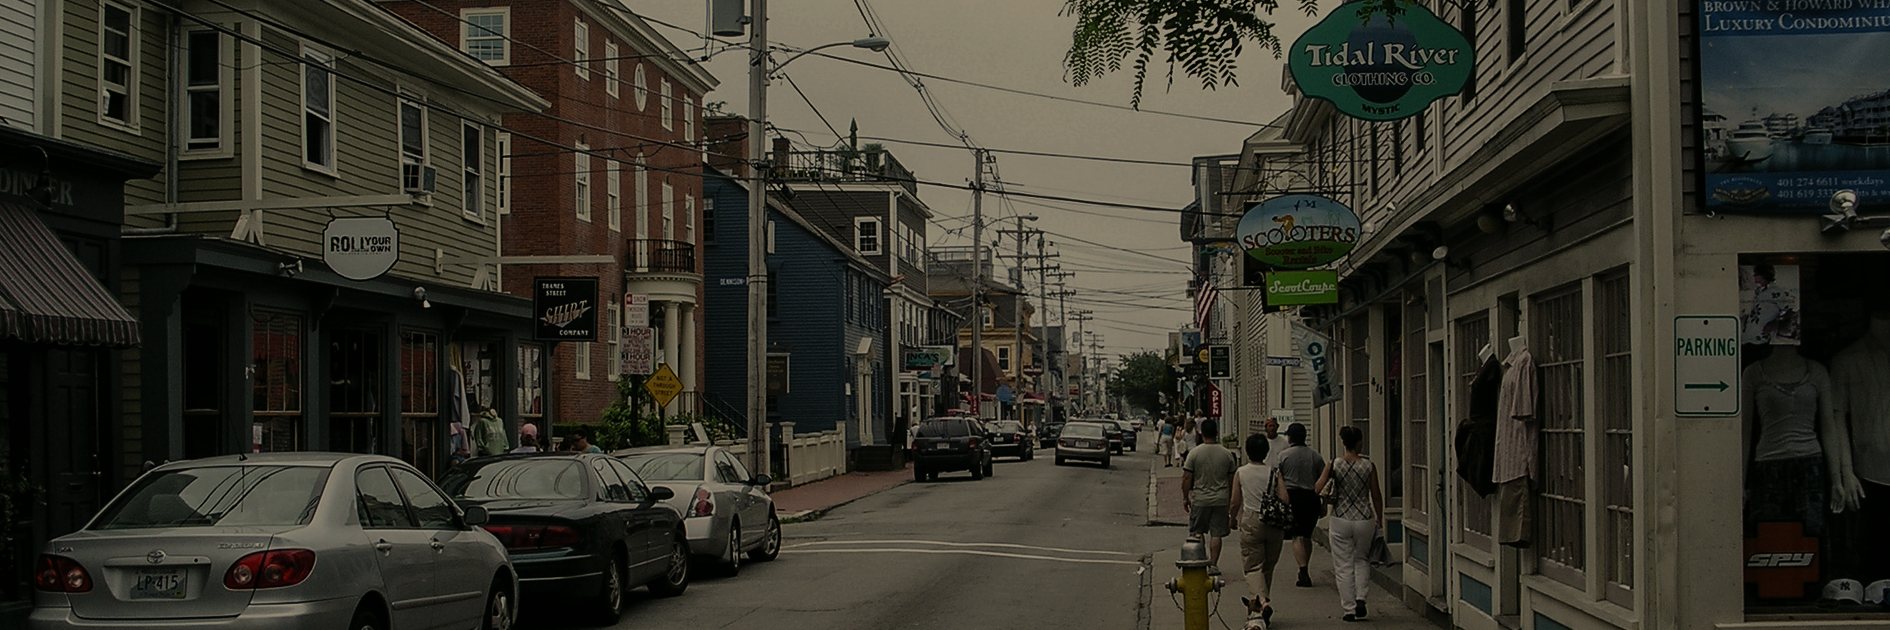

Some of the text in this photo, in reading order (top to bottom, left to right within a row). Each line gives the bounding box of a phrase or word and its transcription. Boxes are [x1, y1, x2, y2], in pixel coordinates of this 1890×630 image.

[1704, 0, 1761, 13] BROWN
[1766, 0, 1780, 11] &
[1785, 0, 1852, 11] HOWARD
[1704, 14, 1775, 32] LUXURY
[1304, 41, 1459, 70] Tidal River
[1332, 72, 1437, 87] CLOTHING CO.
[1361, 104, 1400, 115] MYSTIC
[1777, 176, 1884, 187] 401 274 6611 weekdays
[1777, 190, 1794, 199] 401
[1797, 190, 1814, 198] 619
[331, 236, 391, 252] ROLL YOUR
[1243, 225, 1355, 250] SCOOTERS
[1269, 279, 1336, 294] ScootCoupe
[545, 300, 588, 325] SHIRT
[1677, 338, 1735, 356] PARKING
[1308, 342, 1332, 399] OPEN
[1212, 390, 1220, 415] OPEN
[1746, 552, 1815, 568] SPY
